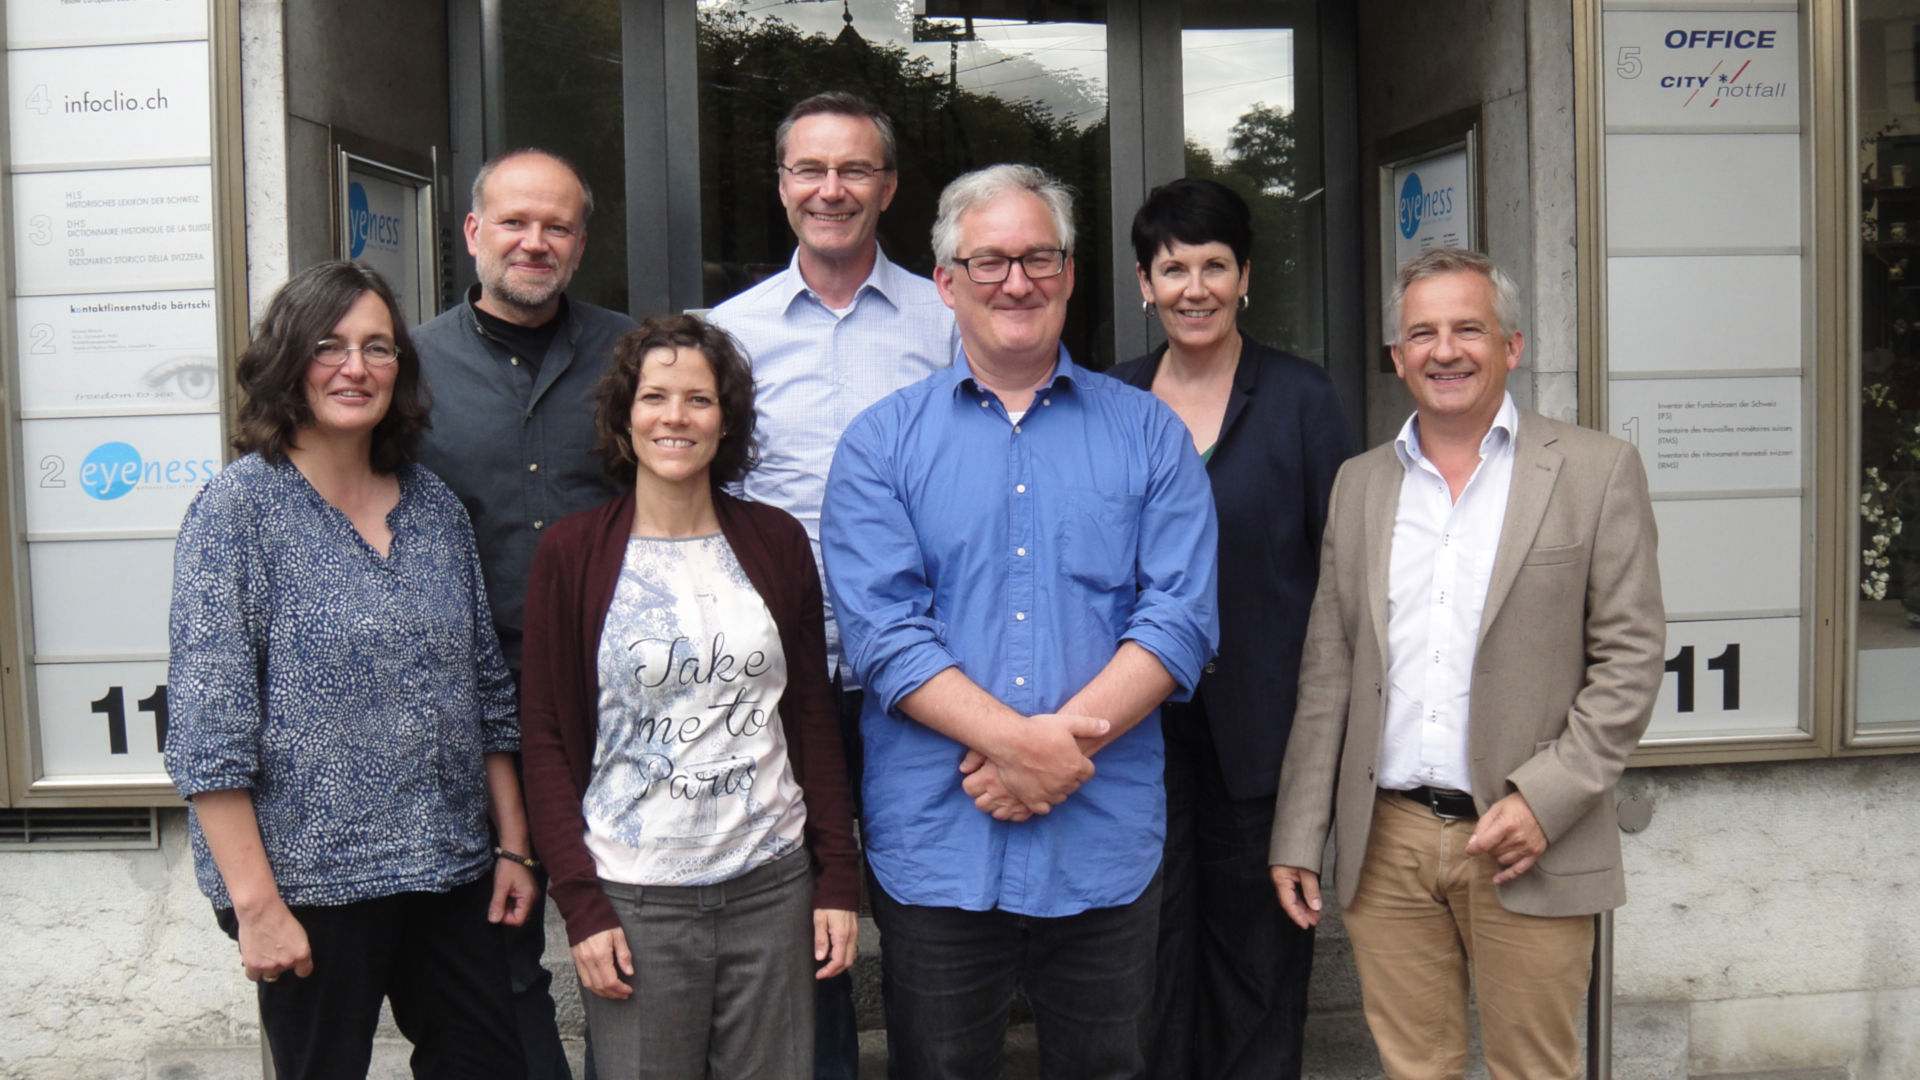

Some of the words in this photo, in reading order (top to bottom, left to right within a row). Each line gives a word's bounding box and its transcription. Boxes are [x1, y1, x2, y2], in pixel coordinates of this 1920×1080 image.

[1664, 29, 1777, 49] OFFICE
[1616, 46, 1643, 79] 5
[1660, 76, 1710, 88] CITY
[1716, 82, 1786, 98] notfall
[25, 83, 52, 115] 4
[64, 88, 168, 114] infoclio.ch
[66, 190, 82, 200] HLS
[66, 199, 116, 209] HISTORISCHES
[118, 198, 149, 207] LEXIKON
[151, 196, 164, 205] DER
[167, 195, 200, 204] SCHWEIZ
[1400, 187, 1454, 232] eyeness
[29, 214, 53, 247] 3
[67, 219, 86, 228] DHS
[166, 225, 176, 233] DE
[350, 208, 399, 249] yeness
[68, 248, 85, 257] DSS
[70, 302, 167, 314] kontaktlinsenstudio
[171, 300, 211, 310] bärtschi
[30, 322, 56, 355] 2
[1622, 416, 1640, 448] 1
[40, 454, 66, 488] 2
[82, 459, 214, 495] eyeness
[628, 632, 771, 688] Take
[1664, 643, 1740, 713] 11
[91, 684, 169, 754] 11
[637, 715, 704, 745] me
[707, 686, 771, 737] to
[633, 752, 754, 801] Paris
